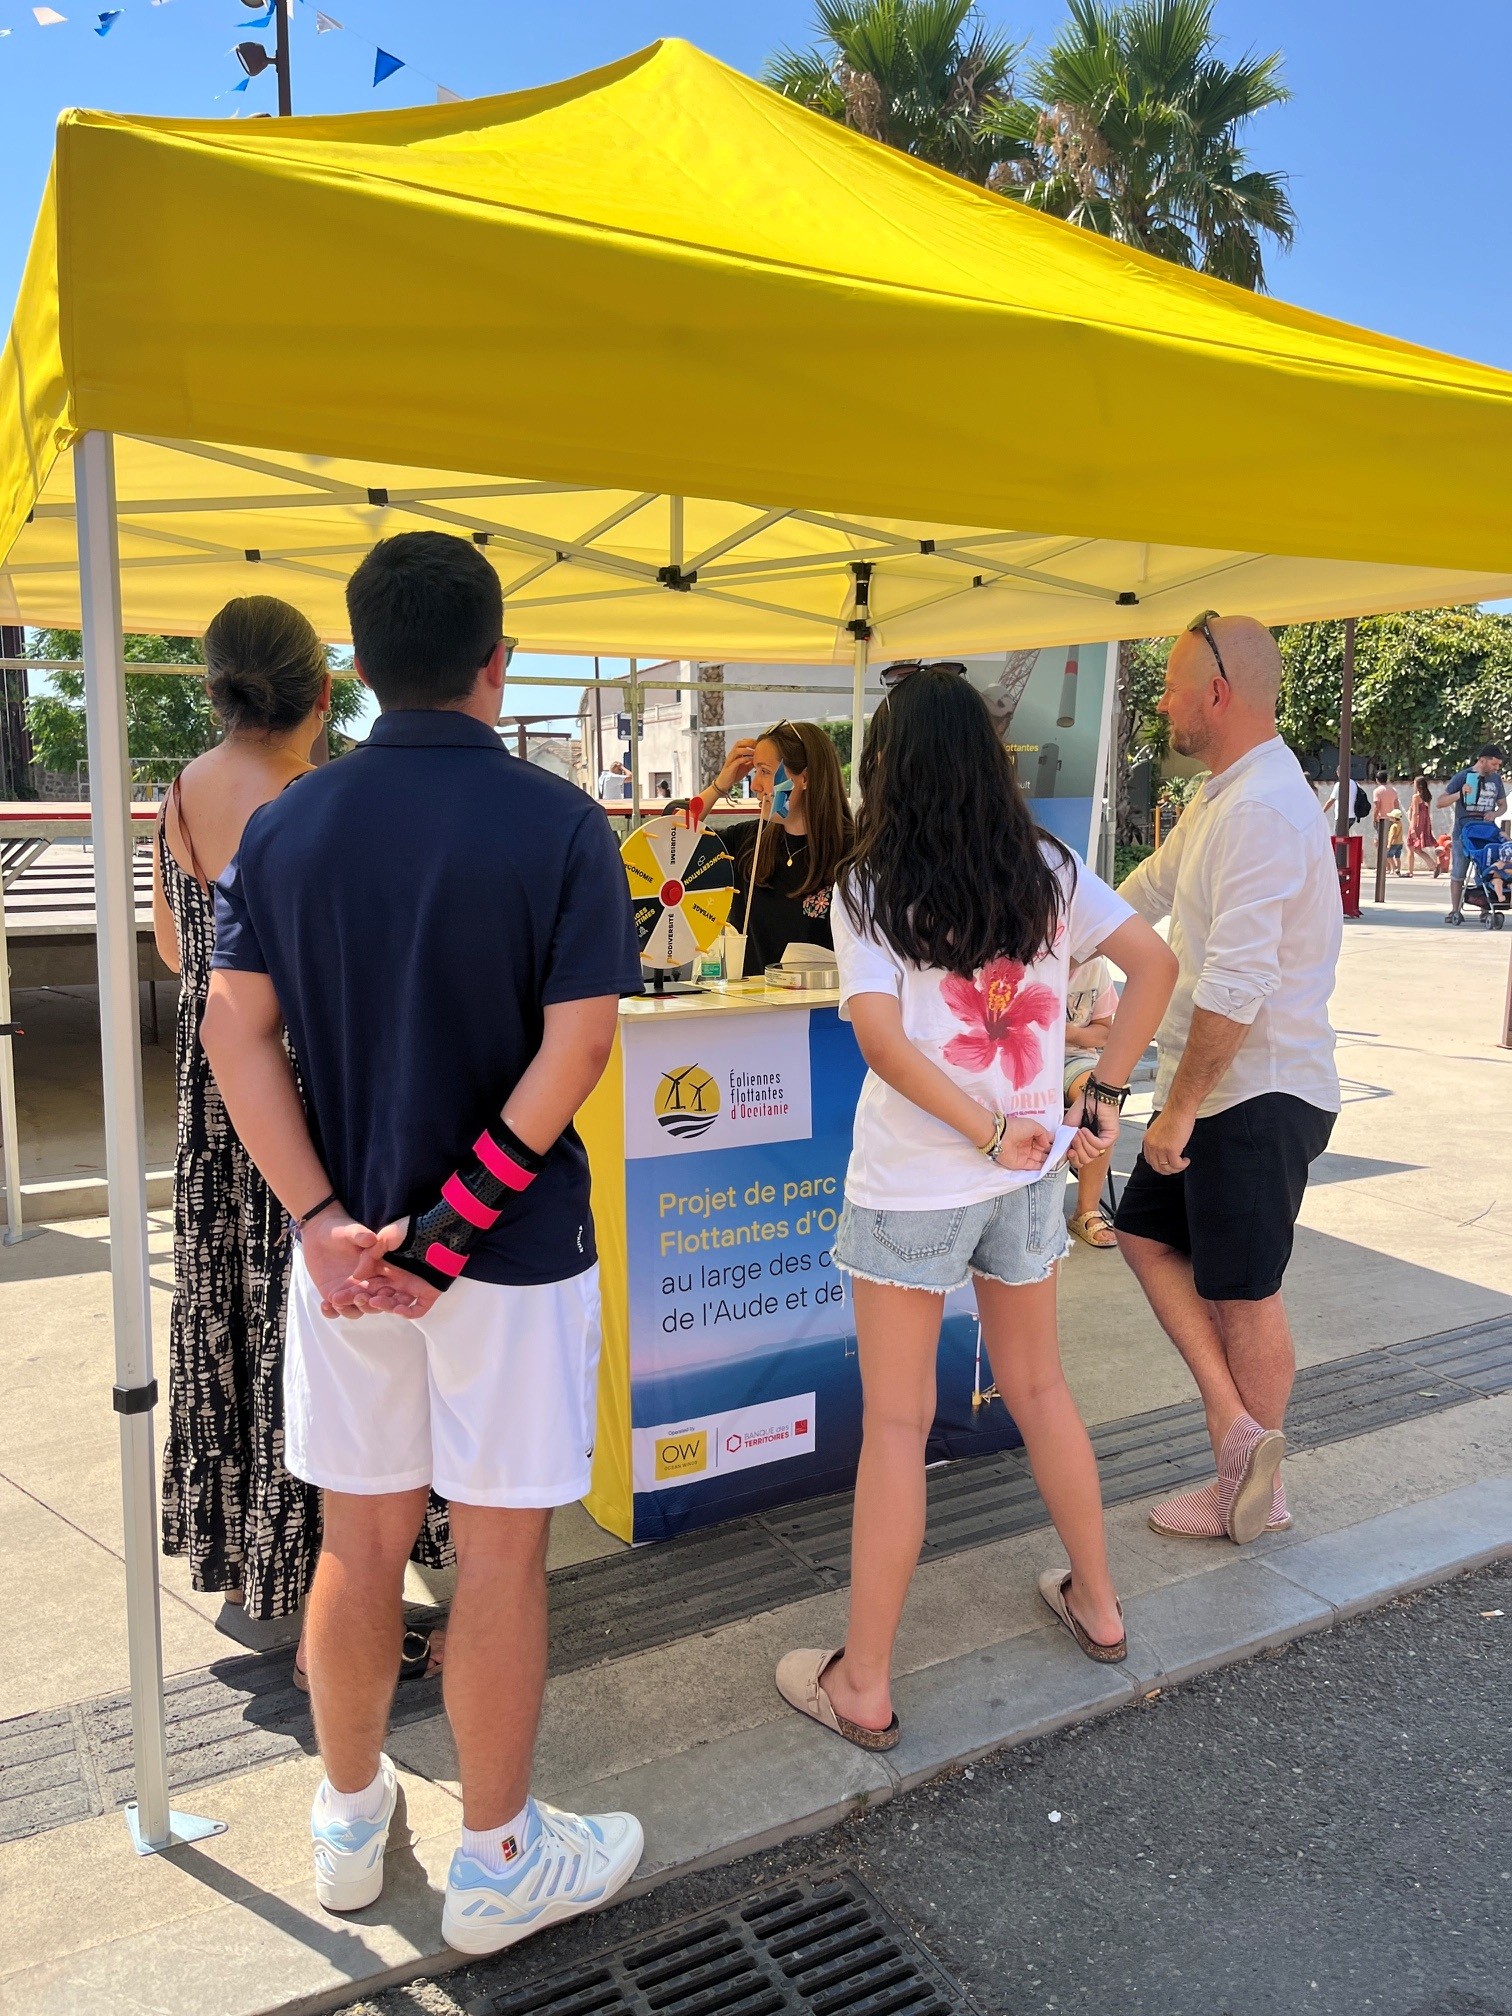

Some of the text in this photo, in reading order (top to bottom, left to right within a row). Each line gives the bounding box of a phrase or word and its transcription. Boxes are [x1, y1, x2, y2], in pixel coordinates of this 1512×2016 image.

[684, 854, 724, 886] ONCERTATION
[692, 903, 716, 922] PAYSAGE
[667, 913, 675, 960] IODIVERSITÉ
[729, 1069, 781, 1088] Éoliennes
[731, 1087, 784, 1105] flottantes
[731, 1102, 789, 1120] d'Occitanie
[659, 1187, 737, 1218] Projet
[744, 1181, 776, 1205] de
[784, 1177, 836, 1206] parc
[660, 1220, 789, 1257] Flottantes
[662, 1274, 692, 1294] au
[701, 1262, 762, 1289] large
[769, 1253, 811, 1276] des
[662, 1281, 843, 1333] de l'Aude et de
[744, 1427, 775, 1440] BANQUE
[744, 1431, 789, 1447] TERRITOIRES
[662, 1440, 700, 1463] OW
